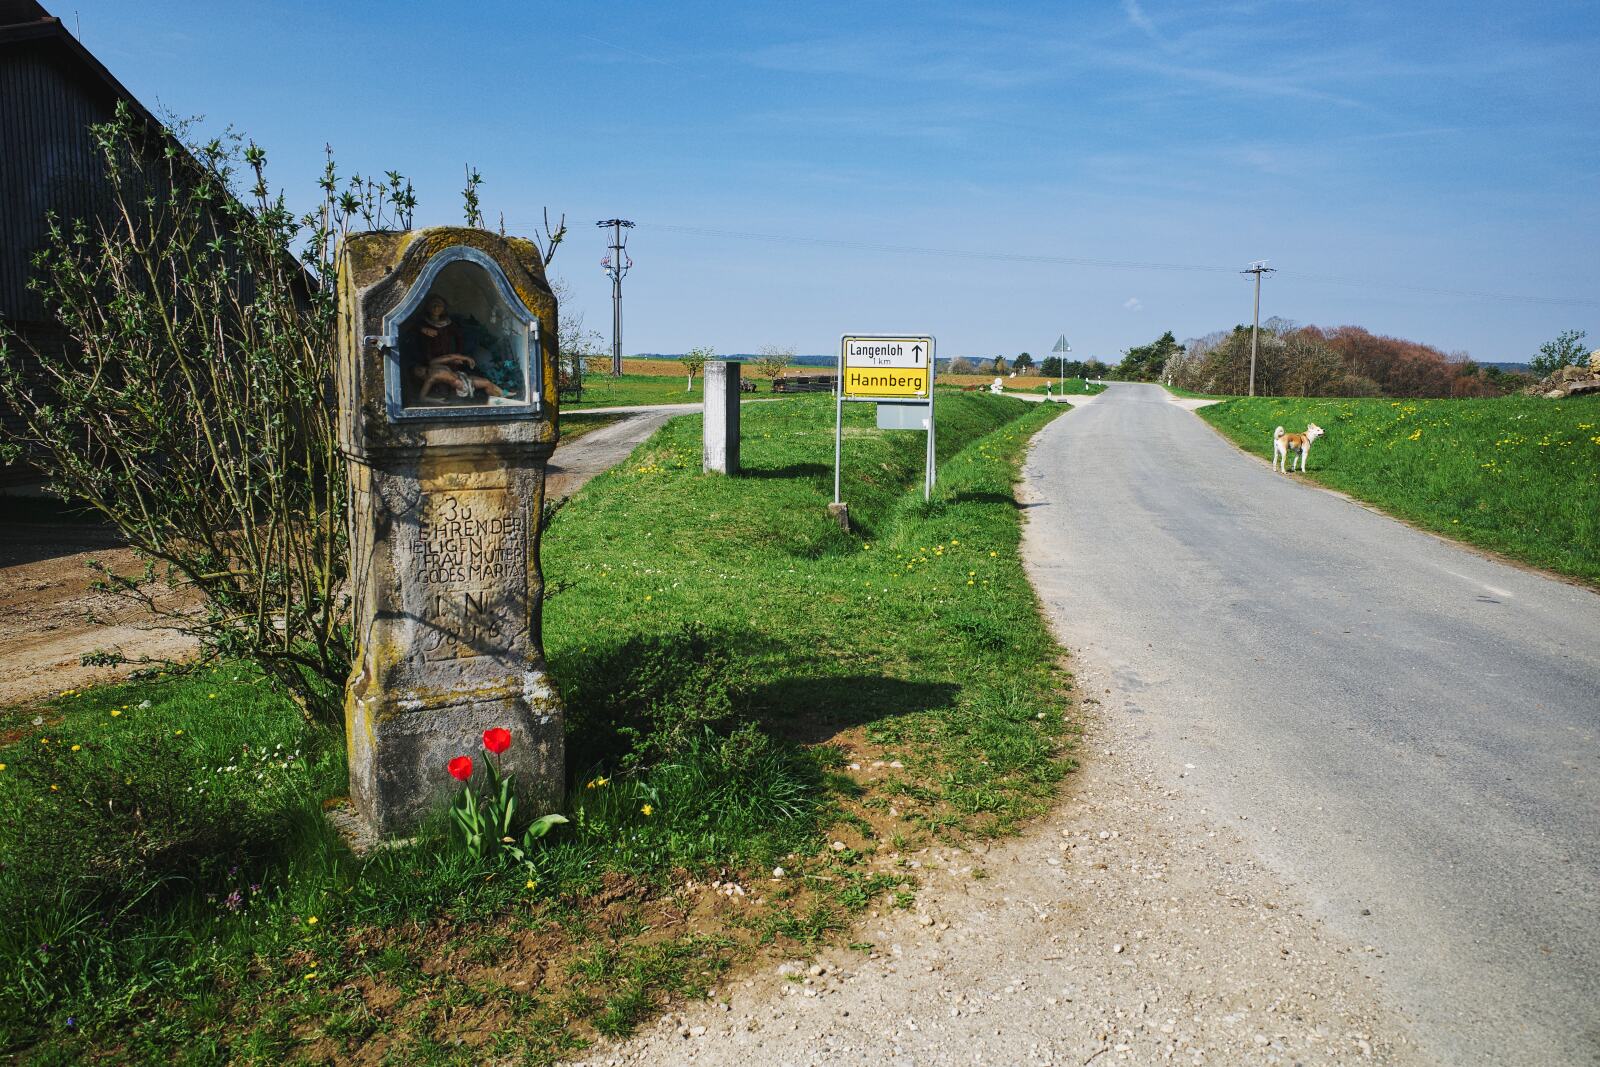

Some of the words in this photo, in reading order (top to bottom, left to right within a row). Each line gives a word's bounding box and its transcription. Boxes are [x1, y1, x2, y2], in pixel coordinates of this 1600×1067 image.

[850, 343, 903, 359] Langenloh
[873, 357, 876, 365] 1
[851, 373, 922, 390] Hannberg
[424, 552, 463, 569] FRAU
[417, 567, 466, 583] GODES
[469, 563, 520, 581] MARIA
